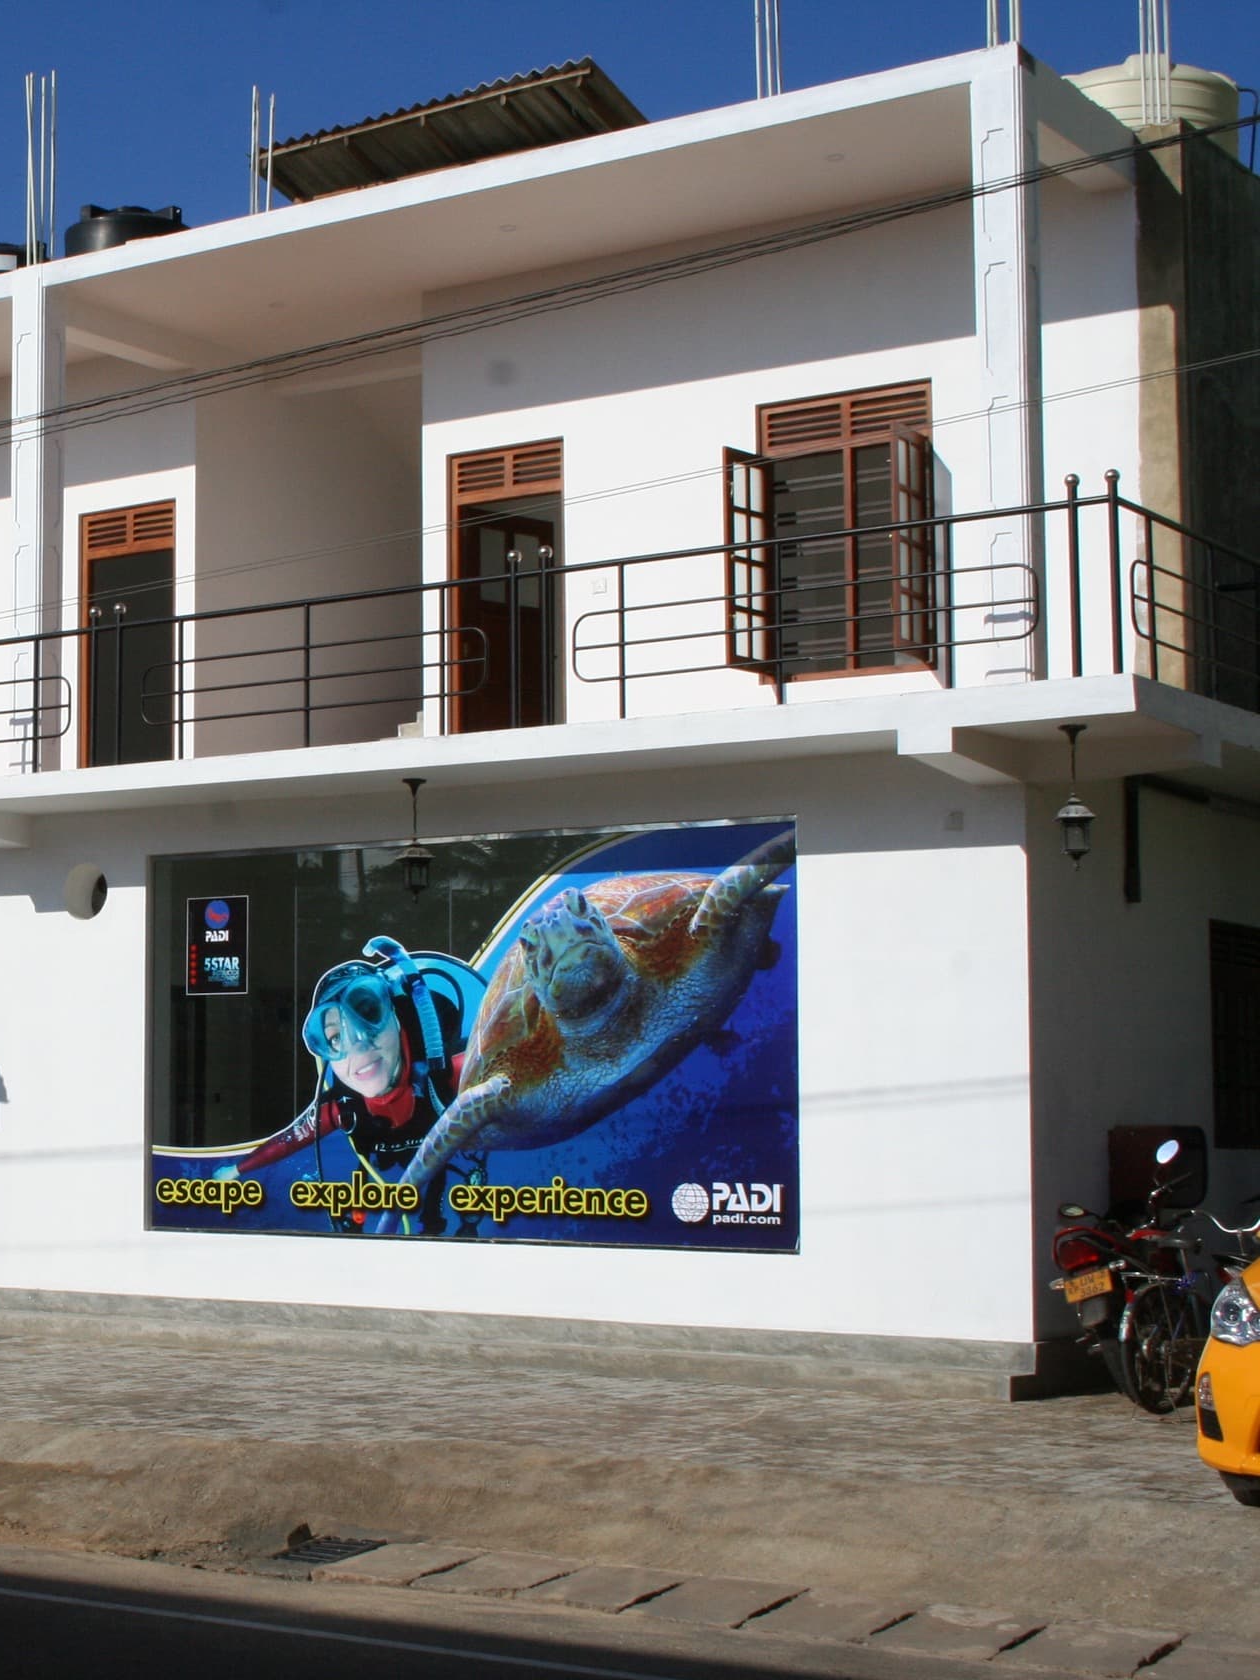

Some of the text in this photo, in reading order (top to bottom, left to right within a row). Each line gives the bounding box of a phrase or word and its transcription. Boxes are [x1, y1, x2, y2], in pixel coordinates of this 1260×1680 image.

[205, 930, 229, 943] PADI
[156, 1171, 648, 1222] escape explore experience
[712, 1182, 782, 1213] PADI
[712, 1213, 781, 1225] padi.com
